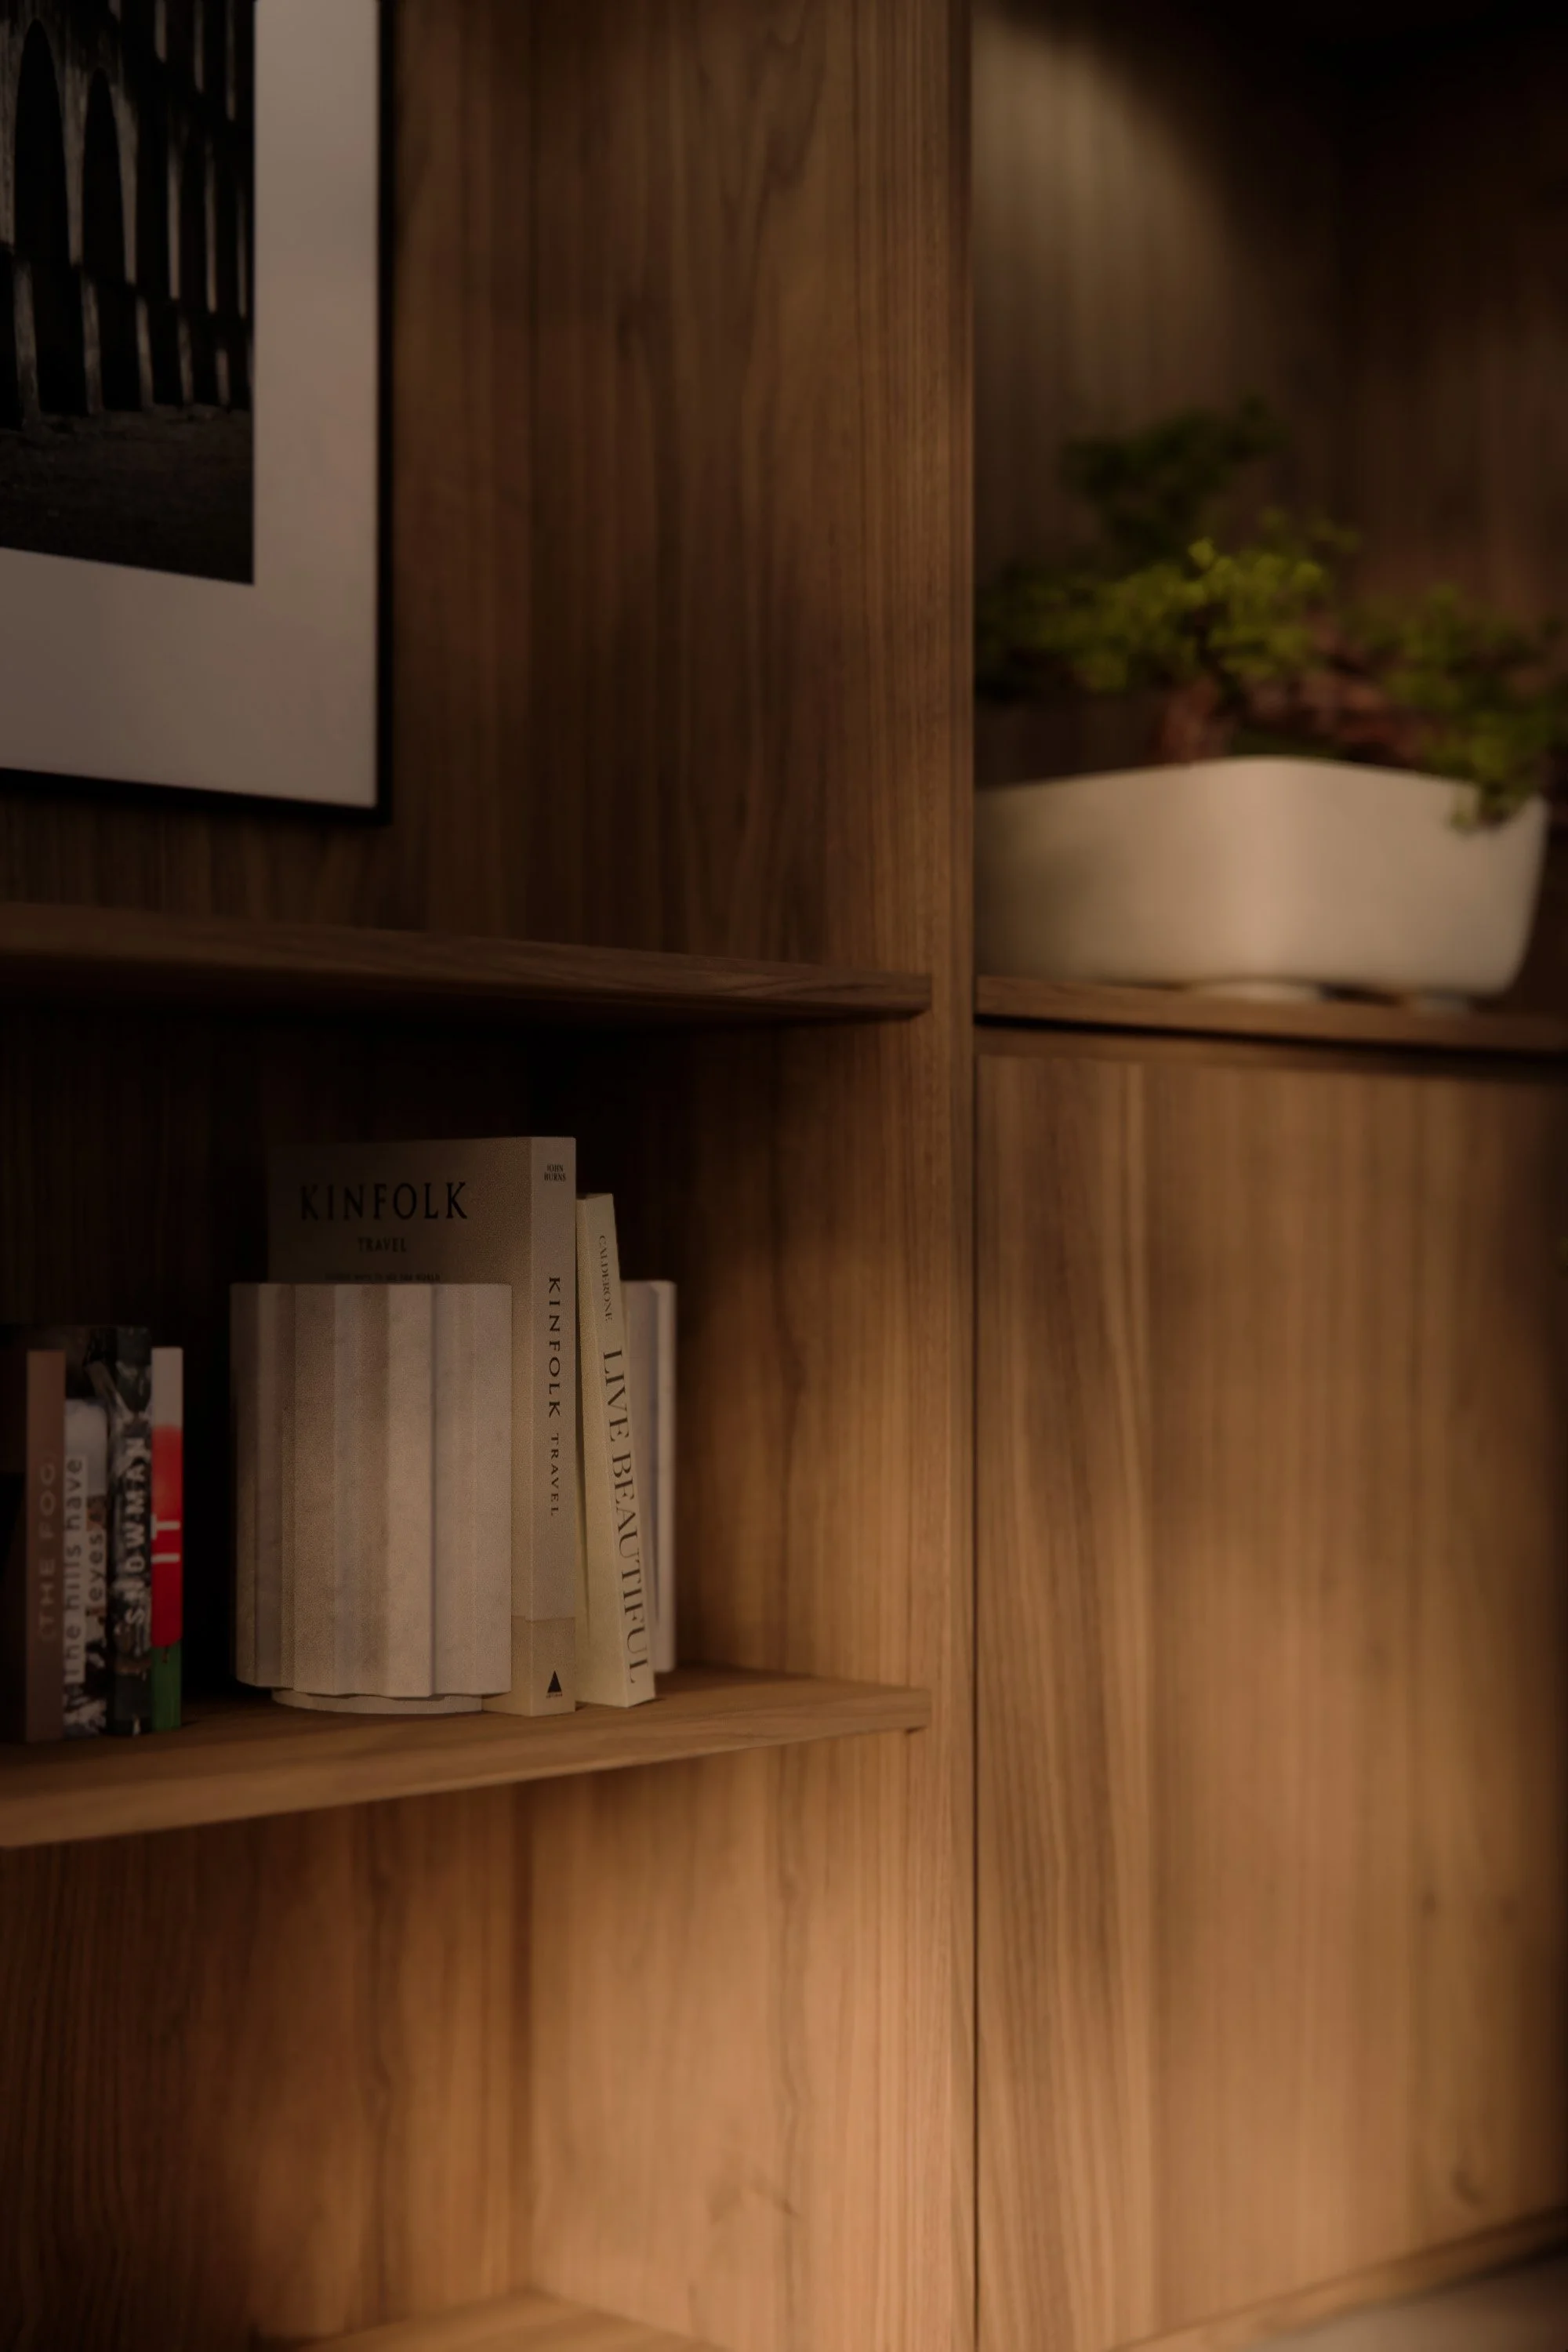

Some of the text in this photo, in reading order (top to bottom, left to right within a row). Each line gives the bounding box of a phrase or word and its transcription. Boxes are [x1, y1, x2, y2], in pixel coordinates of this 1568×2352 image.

[300, 1181, 470, 1221] KINFOLK
[544, 1172, 566, 1181] BURNS
[546, 1163, 564, 1172] JOHN
[358, 1236, 406, 1253] TRAVEL
[598, 1235, 613, 1323] CALDERONE
[548, 1276, 561, 1518] KINFOLK TRAVEL
[64, 1457, 82, 1532] have
[603, 1348, 650, 1685] LIVE BEAUTIFUL
[123, 1436, 146, 1625] SNOWMAN
[151, 1514, 181, 1565] IT
[64, 1543, 82, 1613] hills
[87, 1533, 103, 1602] eyes
